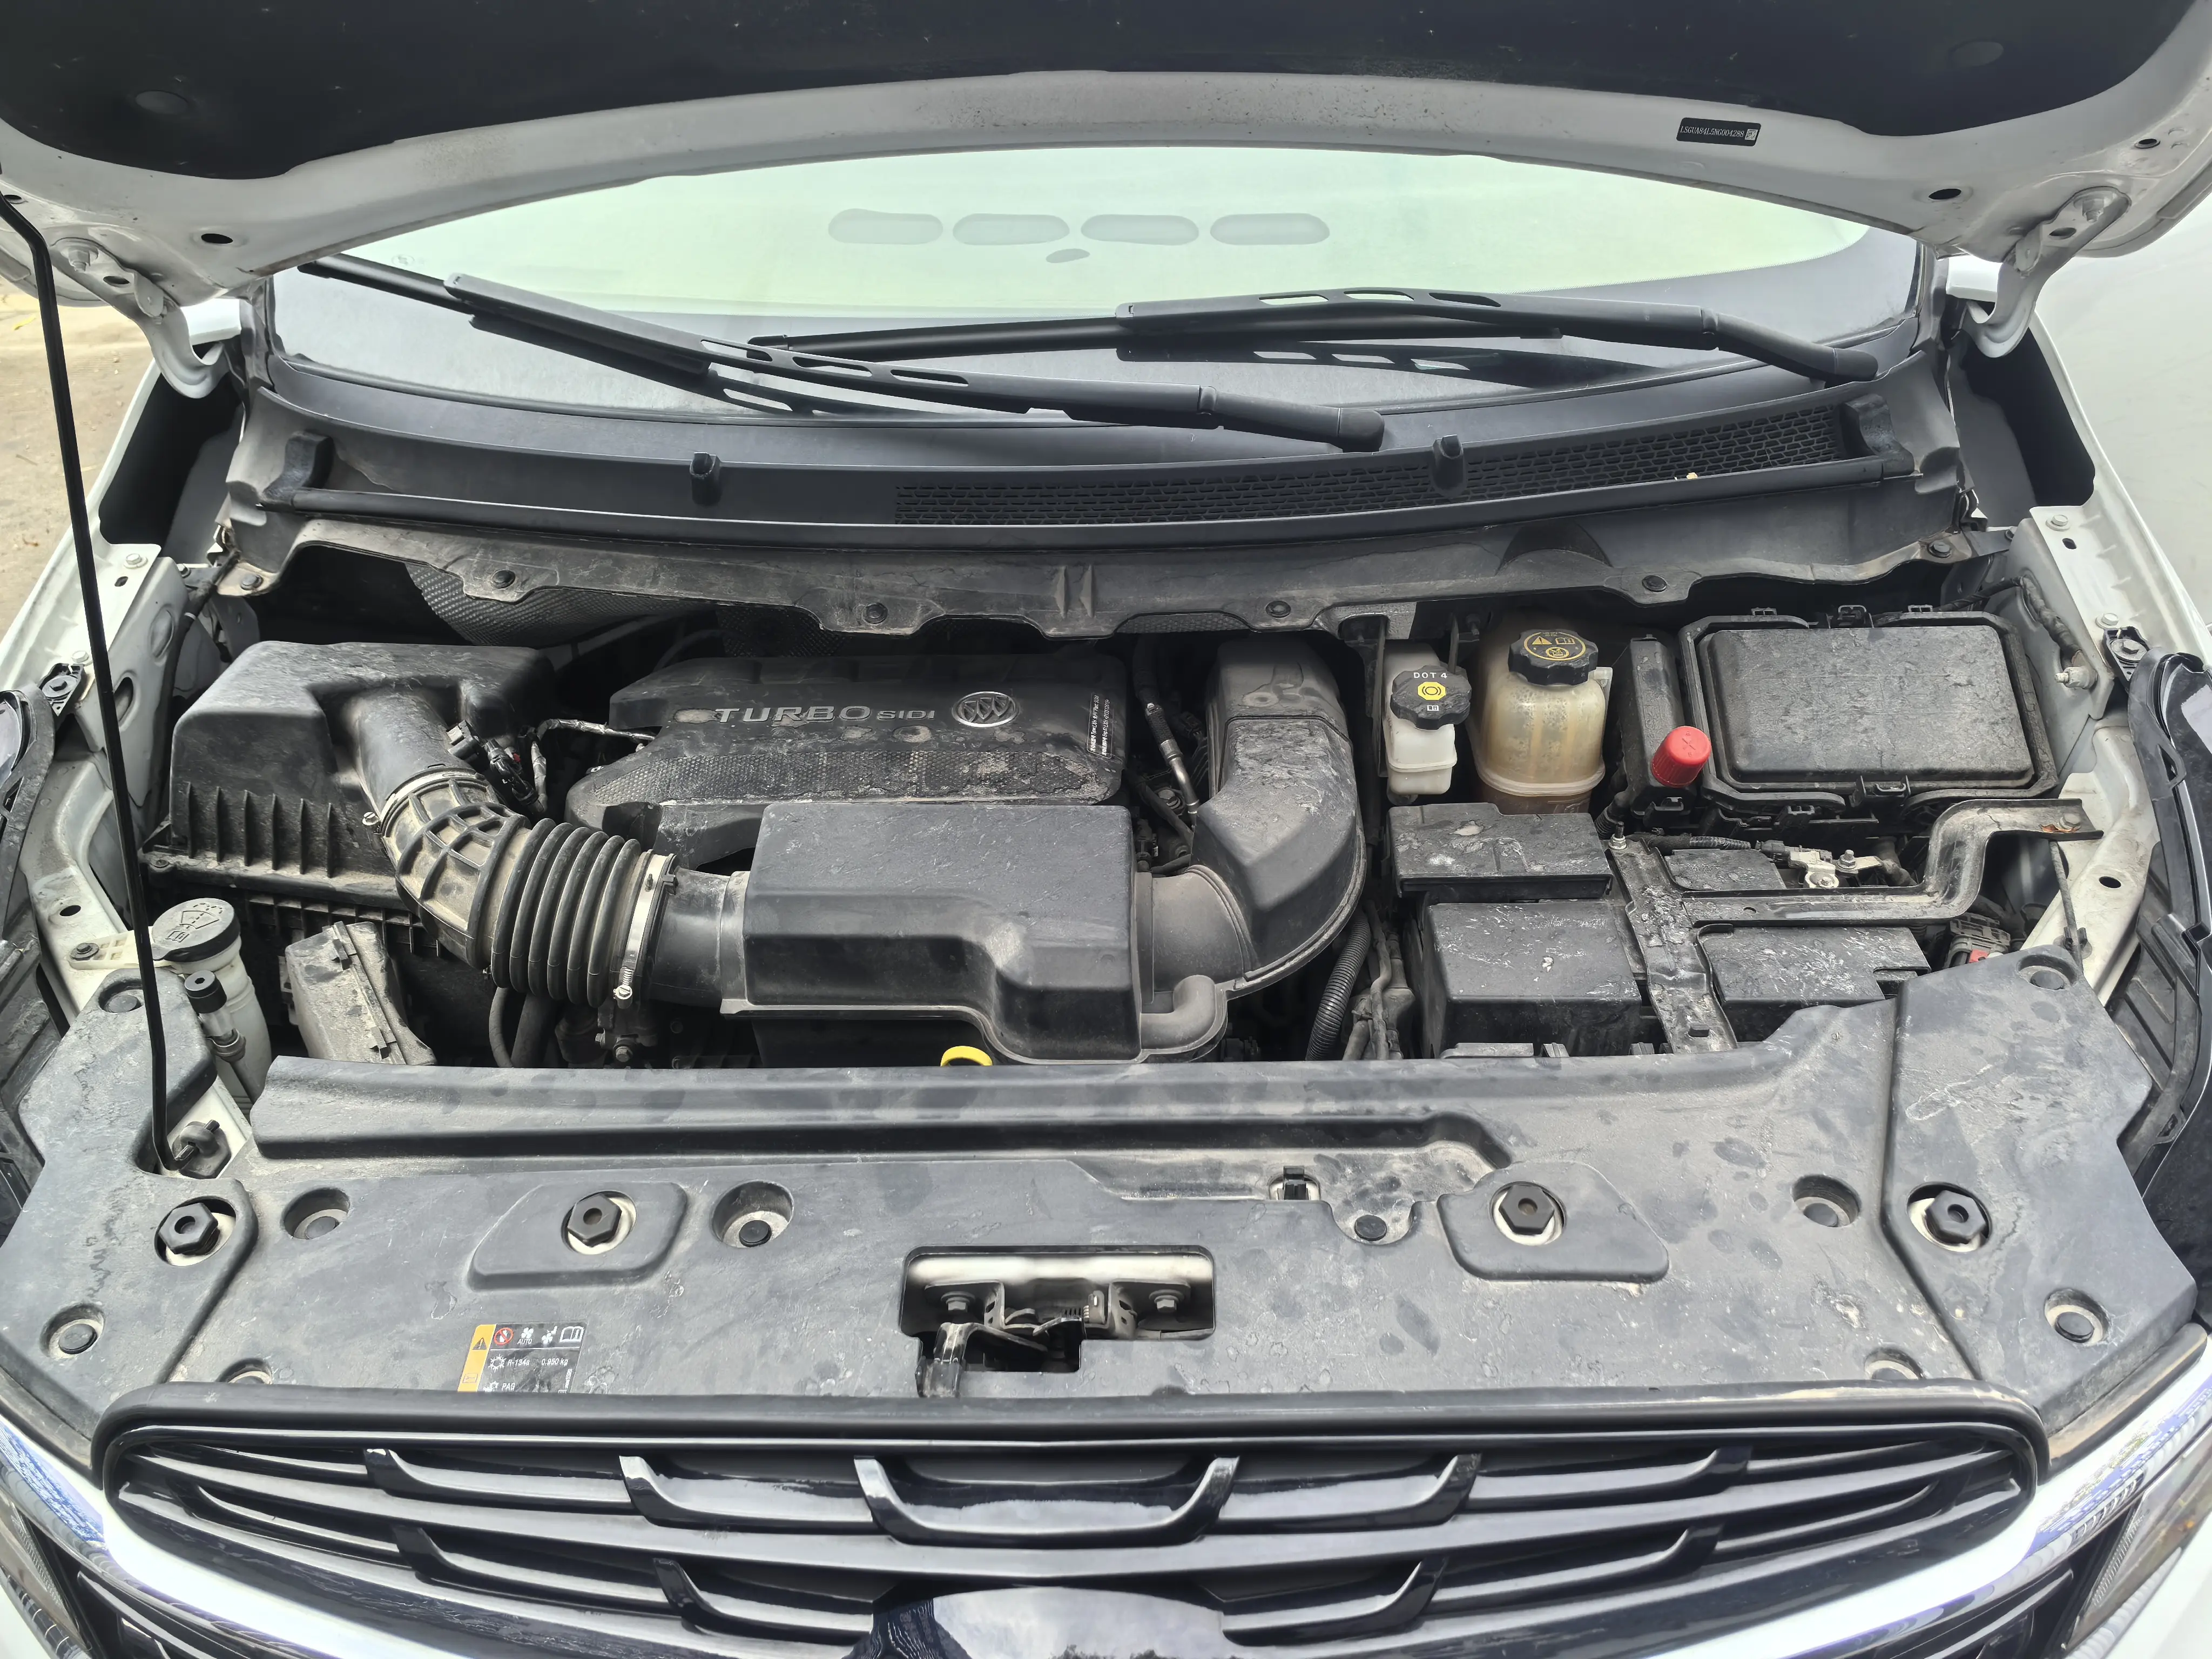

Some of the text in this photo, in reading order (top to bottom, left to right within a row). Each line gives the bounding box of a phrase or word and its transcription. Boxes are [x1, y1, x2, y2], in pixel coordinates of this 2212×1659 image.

[715, 705, 935, 723] TURBO SIDI
[507, 1358, 530, 1366] R-134a
[560, 1358, 569, 1367] kg
[501, 1382, 516, 1391] PAG
